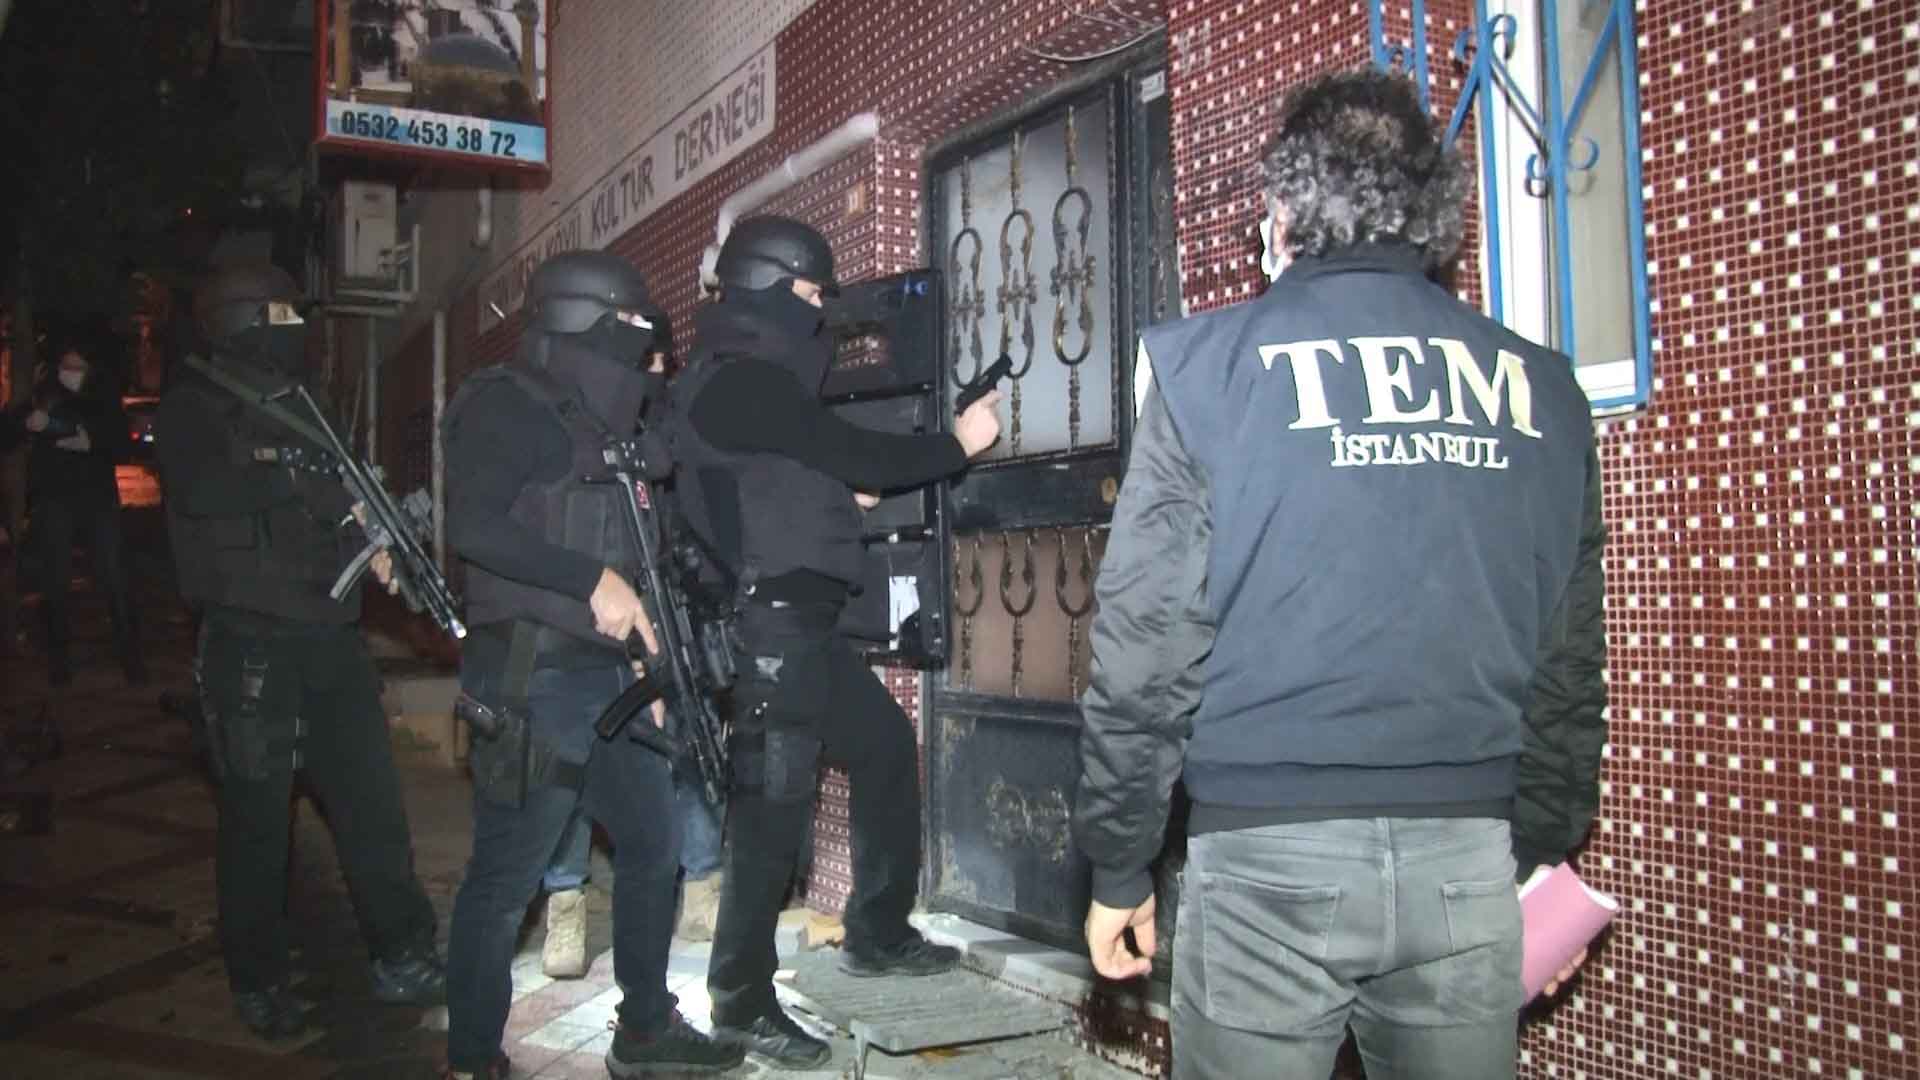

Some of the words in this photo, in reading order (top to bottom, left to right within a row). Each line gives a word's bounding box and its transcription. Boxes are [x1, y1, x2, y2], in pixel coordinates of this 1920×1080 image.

[341, 110, 399, 142] 0532
[407, 119, 448, 147] 453
[456, 126, 482, 154] 38
[490, 131, 516, 157] 72
[674, 54, 764, 182] DERNEĞİ
[1258, 336, 1543, 439] TEM
[1329, 425, 1509, 470] İSTANBUL
